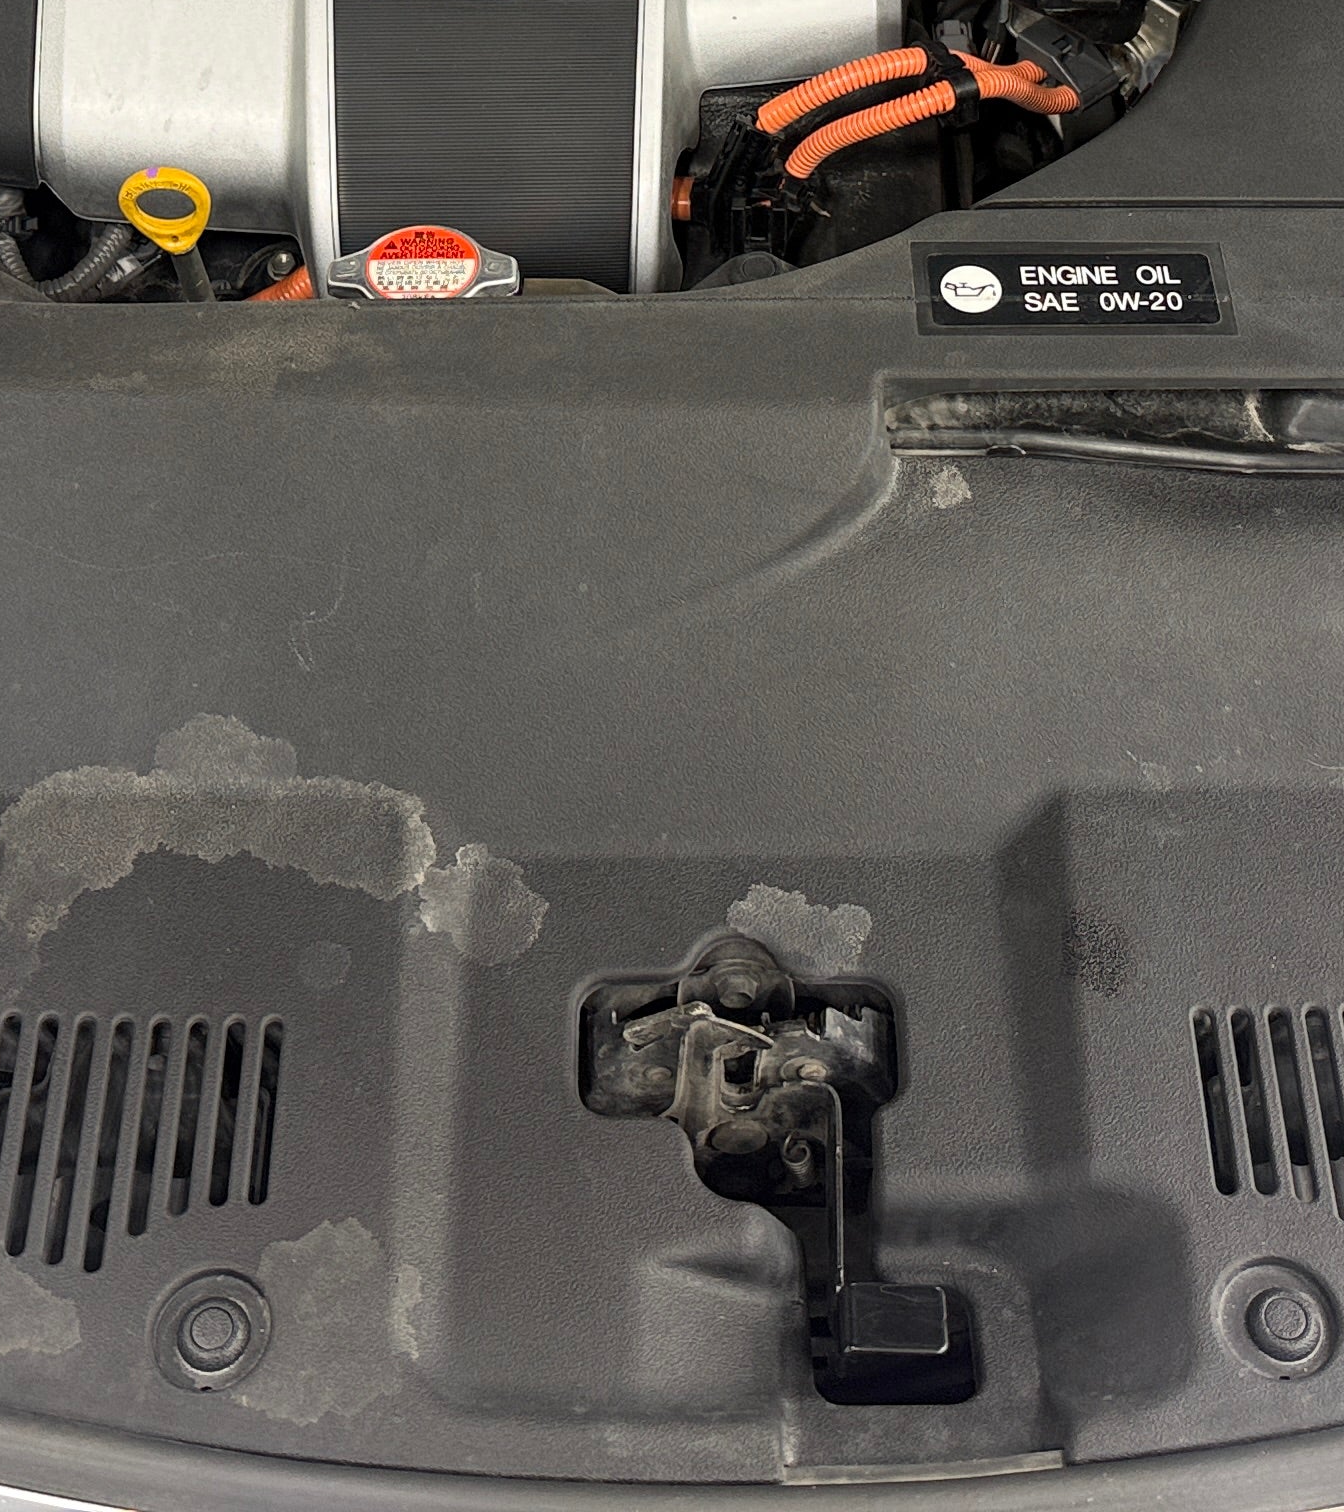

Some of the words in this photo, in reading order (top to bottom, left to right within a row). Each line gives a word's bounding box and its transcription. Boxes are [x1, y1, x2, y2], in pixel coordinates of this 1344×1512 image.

[400, 238, 454, 247] WARNING
[1019, 266, 1119, 285] ENGINE
[1136, 265, 1181, 285] OIL
[1024, 292, 1080, 311] SAE
[1099, 291, 1184, 311] 0W-20
